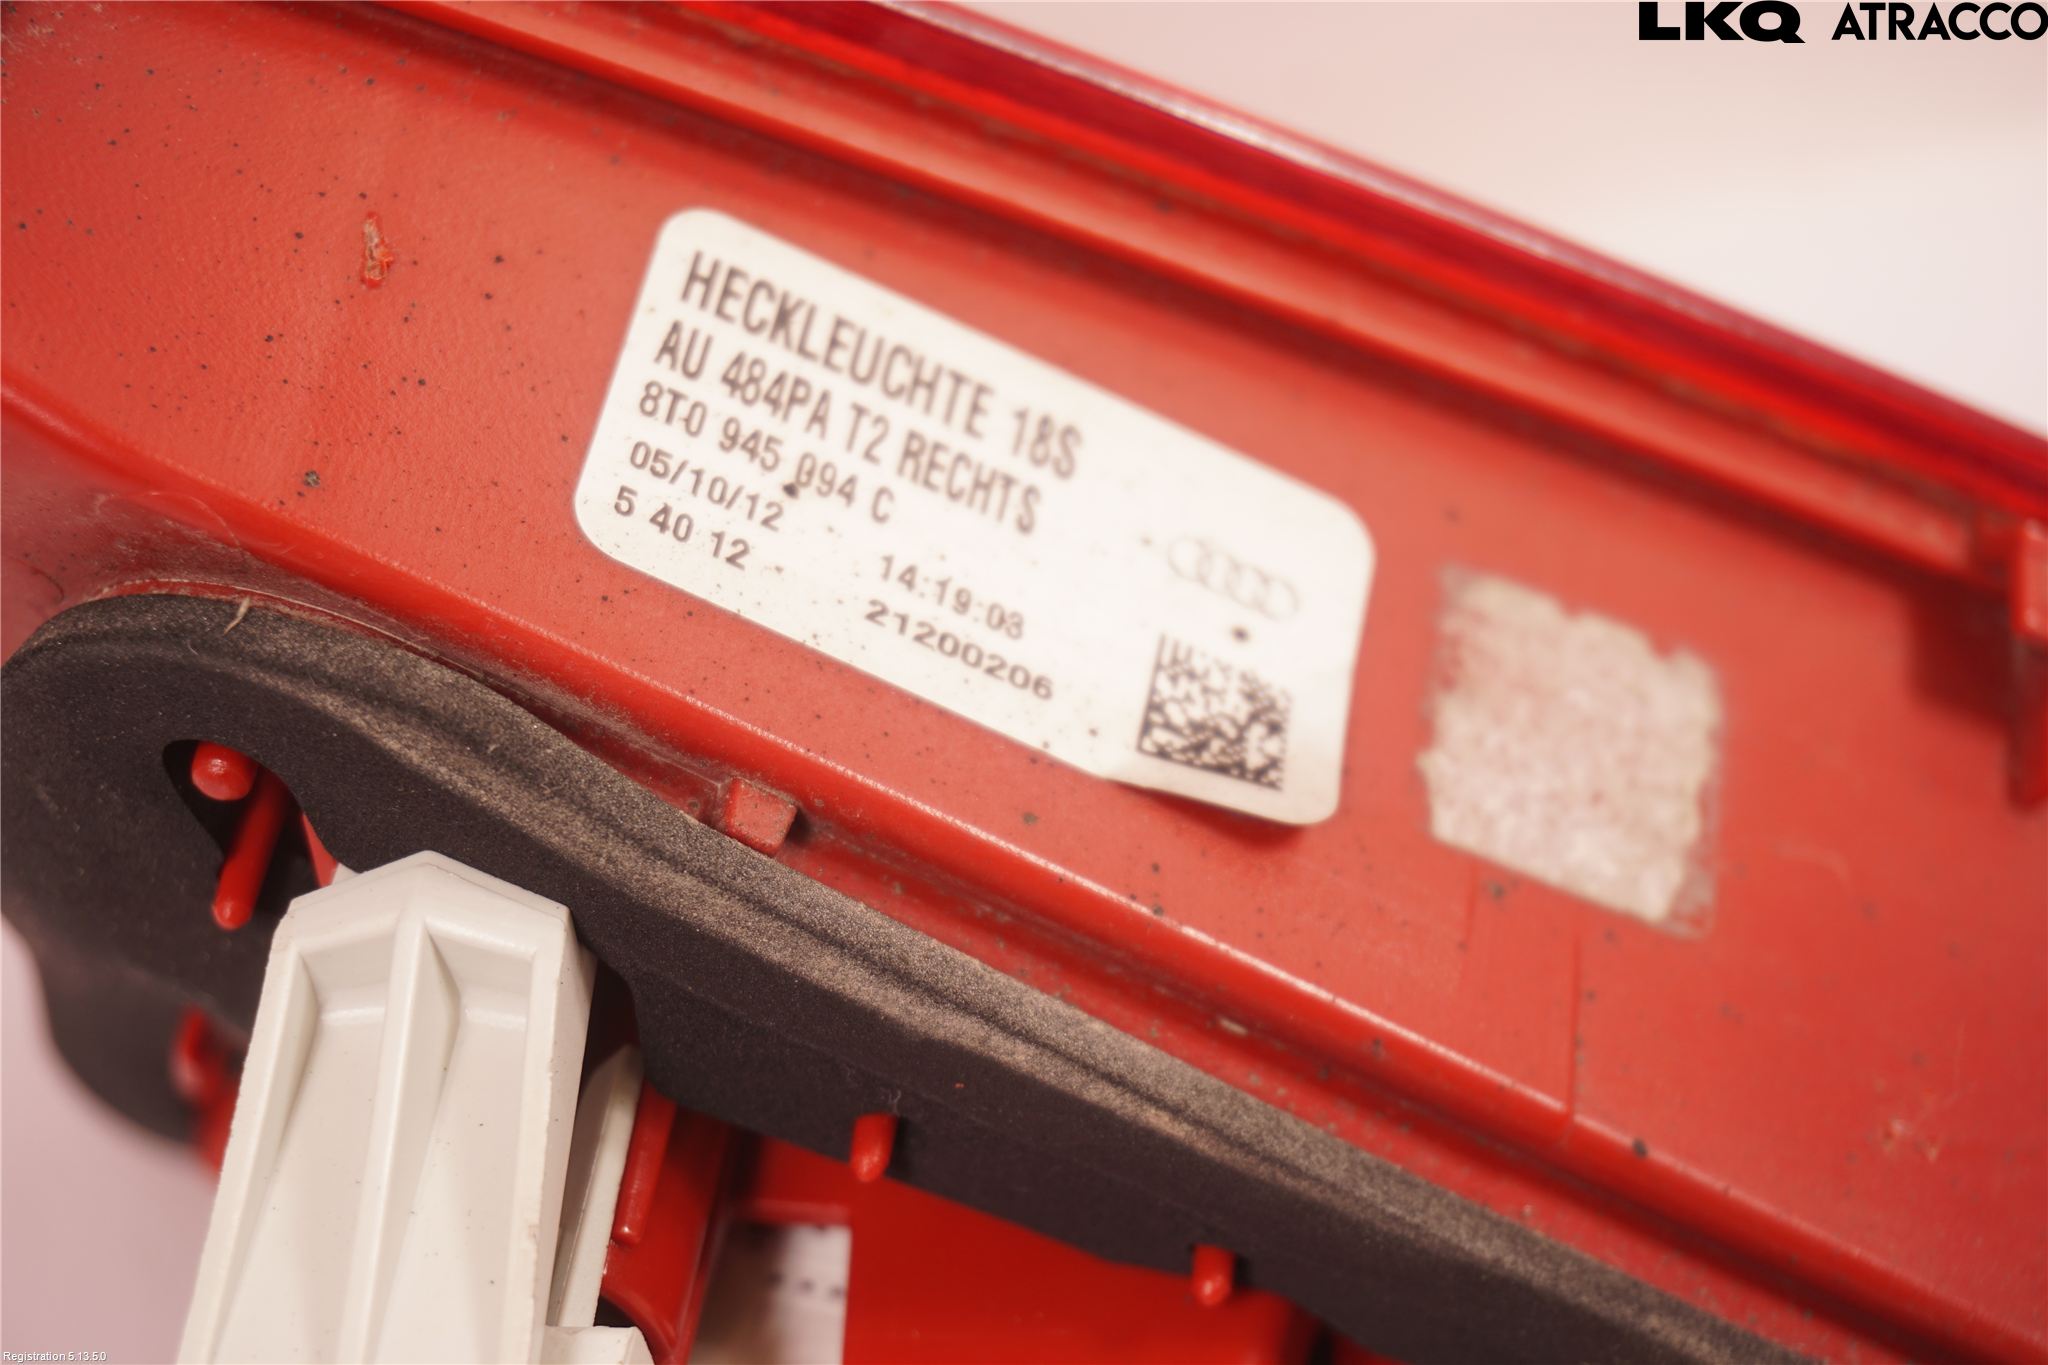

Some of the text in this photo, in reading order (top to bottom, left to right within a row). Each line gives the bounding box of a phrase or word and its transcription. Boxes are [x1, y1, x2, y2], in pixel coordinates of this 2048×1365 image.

[681, 249, 1085, 480] HECKLEUCHTE 18S
[655, 319, 1043, 535] AU 484PA T2 RECHTS
[718, 417, 782, 472] 945
[795, 453, 858, 505] 094
[871, 484, 896, 524] C
[613, 485, 751, 570] 5 40 12
[628, 440, 785, 531] 05/10/12
[879, 553, 1026, 641] 14:19:03
[864, 599, 1053, 701] 21200206
